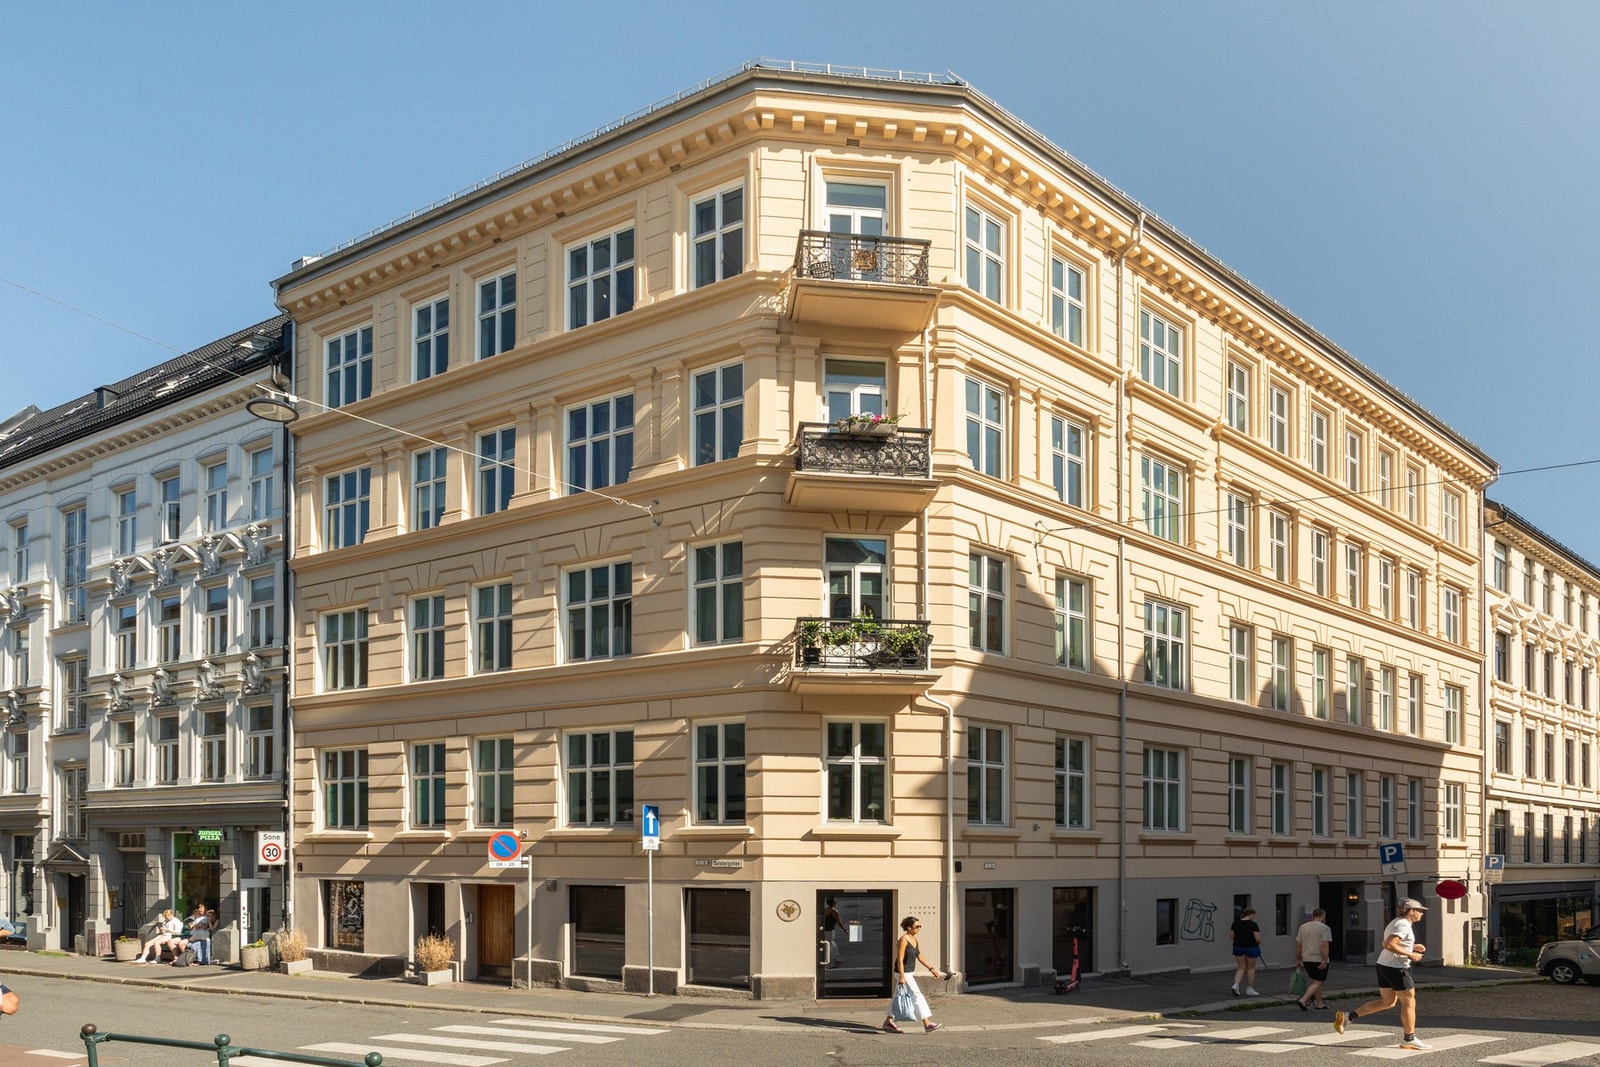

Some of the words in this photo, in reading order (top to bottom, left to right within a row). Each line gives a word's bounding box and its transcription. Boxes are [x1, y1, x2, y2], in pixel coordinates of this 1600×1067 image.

[263, 833, 280, 841] Sone
[190, 846, 216, 857] PIZZA
[265, 848, 279, 857] 30
[1384, 846, 1397, 862] P
[1489, 857, 1499, 868] P
